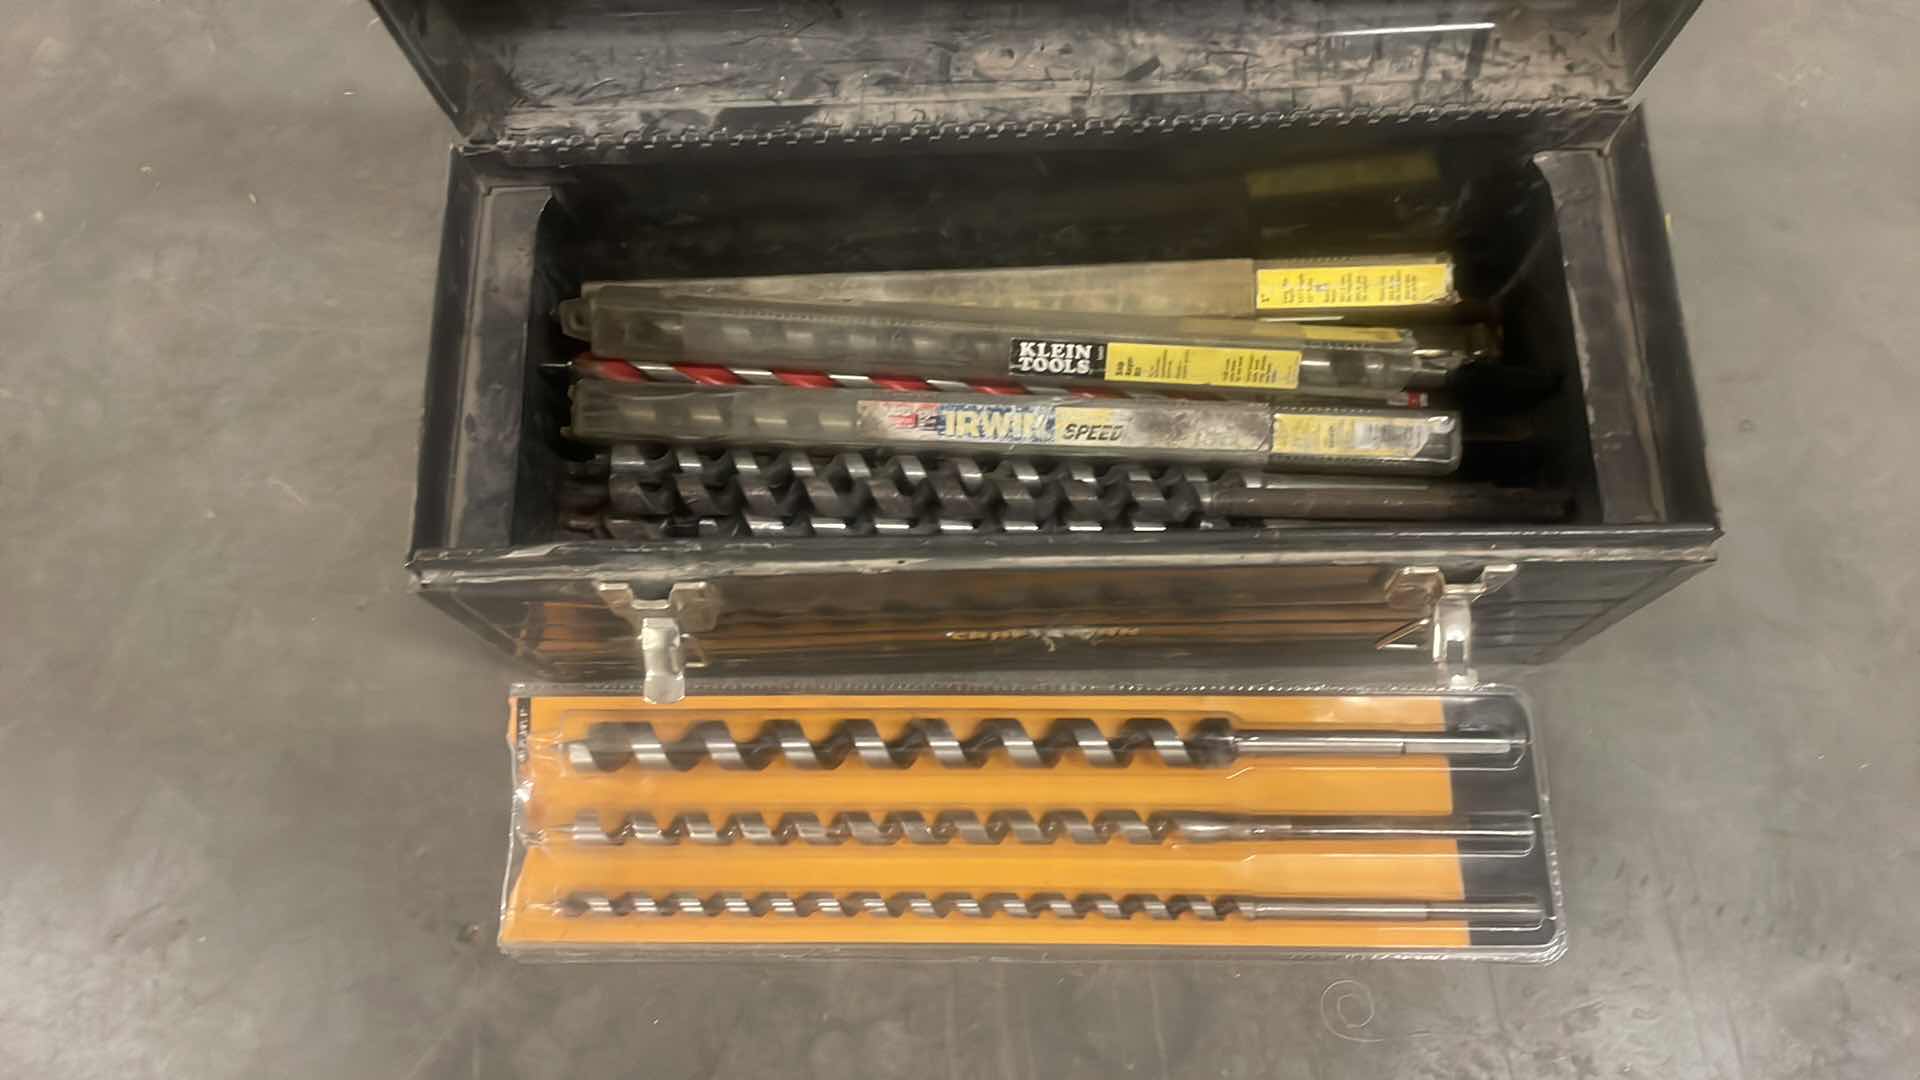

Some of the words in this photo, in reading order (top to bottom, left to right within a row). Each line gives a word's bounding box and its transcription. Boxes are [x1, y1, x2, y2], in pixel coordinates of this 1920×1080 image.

[1019, 342, 1093, 359] KLEIN
[1018, 357, 1091, 374] TOOLS
[943, 409, 1052, 441] IRWIN
